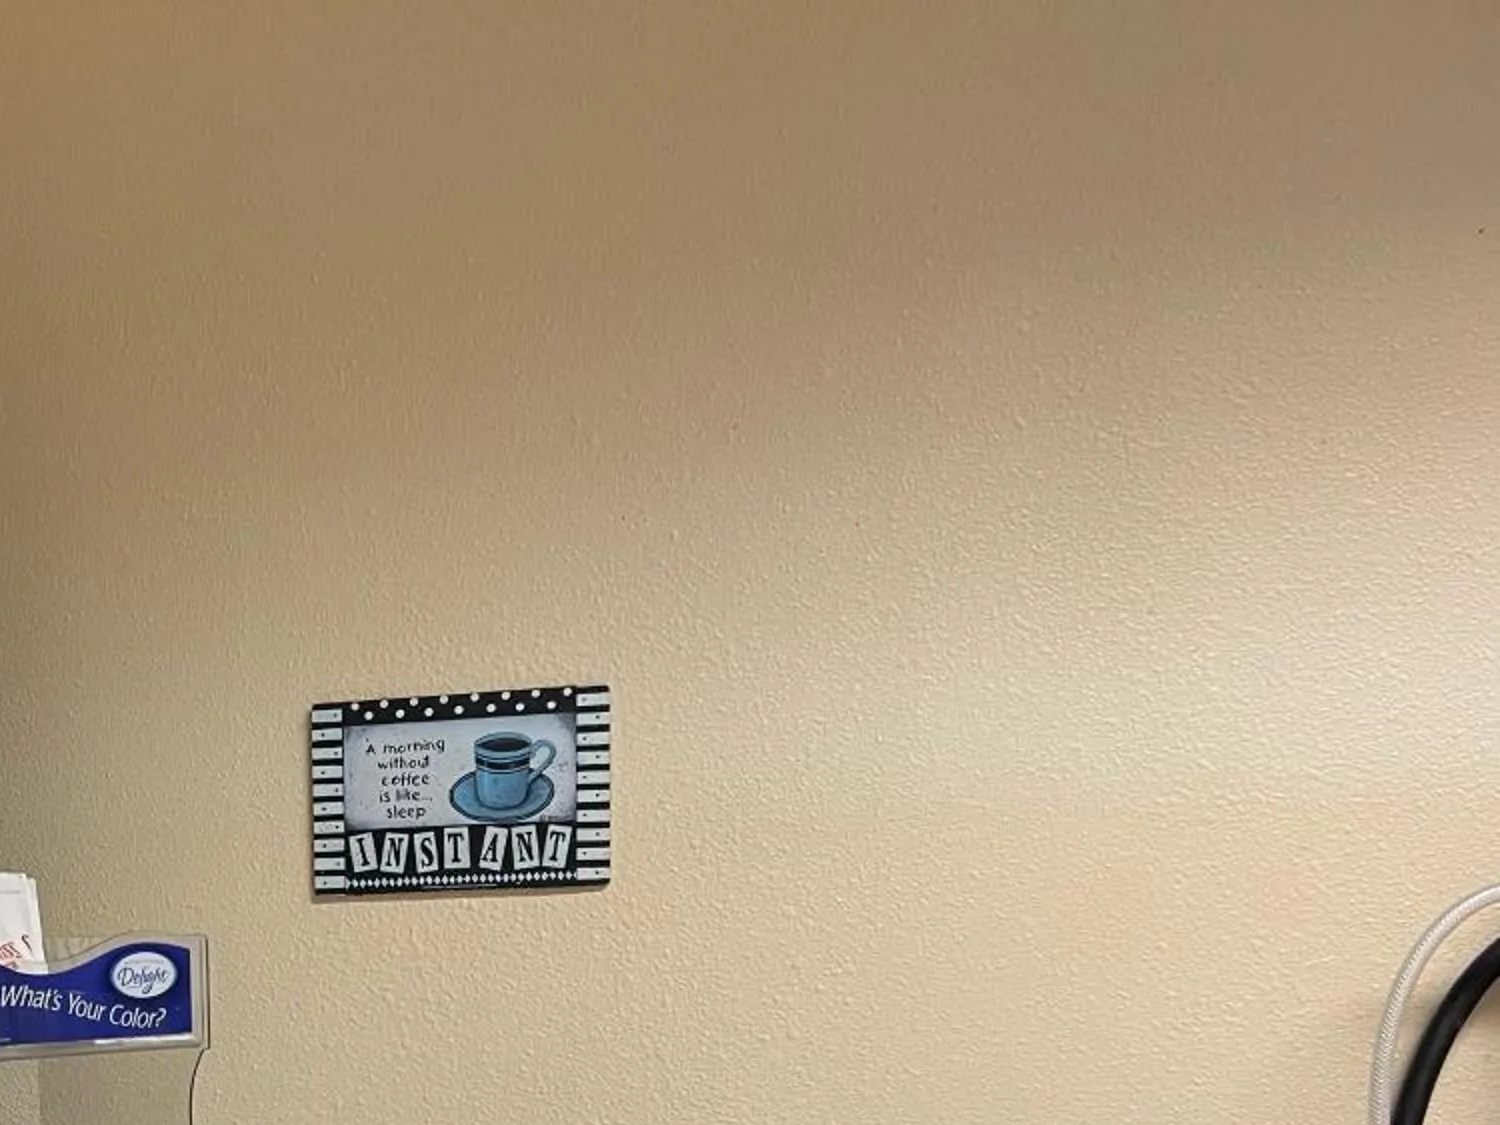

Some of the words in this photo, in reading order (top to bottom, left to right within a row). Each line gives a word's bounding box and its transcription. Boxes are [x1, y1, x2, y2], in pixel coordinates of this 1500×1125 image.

[365, 742, 377, 756] A
[383, 738, 445, 754] morning
[377, 755, 430, 770] without
[381, 772, 430, 787] coffee
[379, 790, 391, 803] is
[386, 804, 427, 820] sleep
[353, 829, 568, 868] INSTANT
[117, 966, 170, 995] Delight
[0, 984, 61, 1011] What's
[67, 993, 105, 1022] Your
[110, 1004, 167, 1029] Color?
